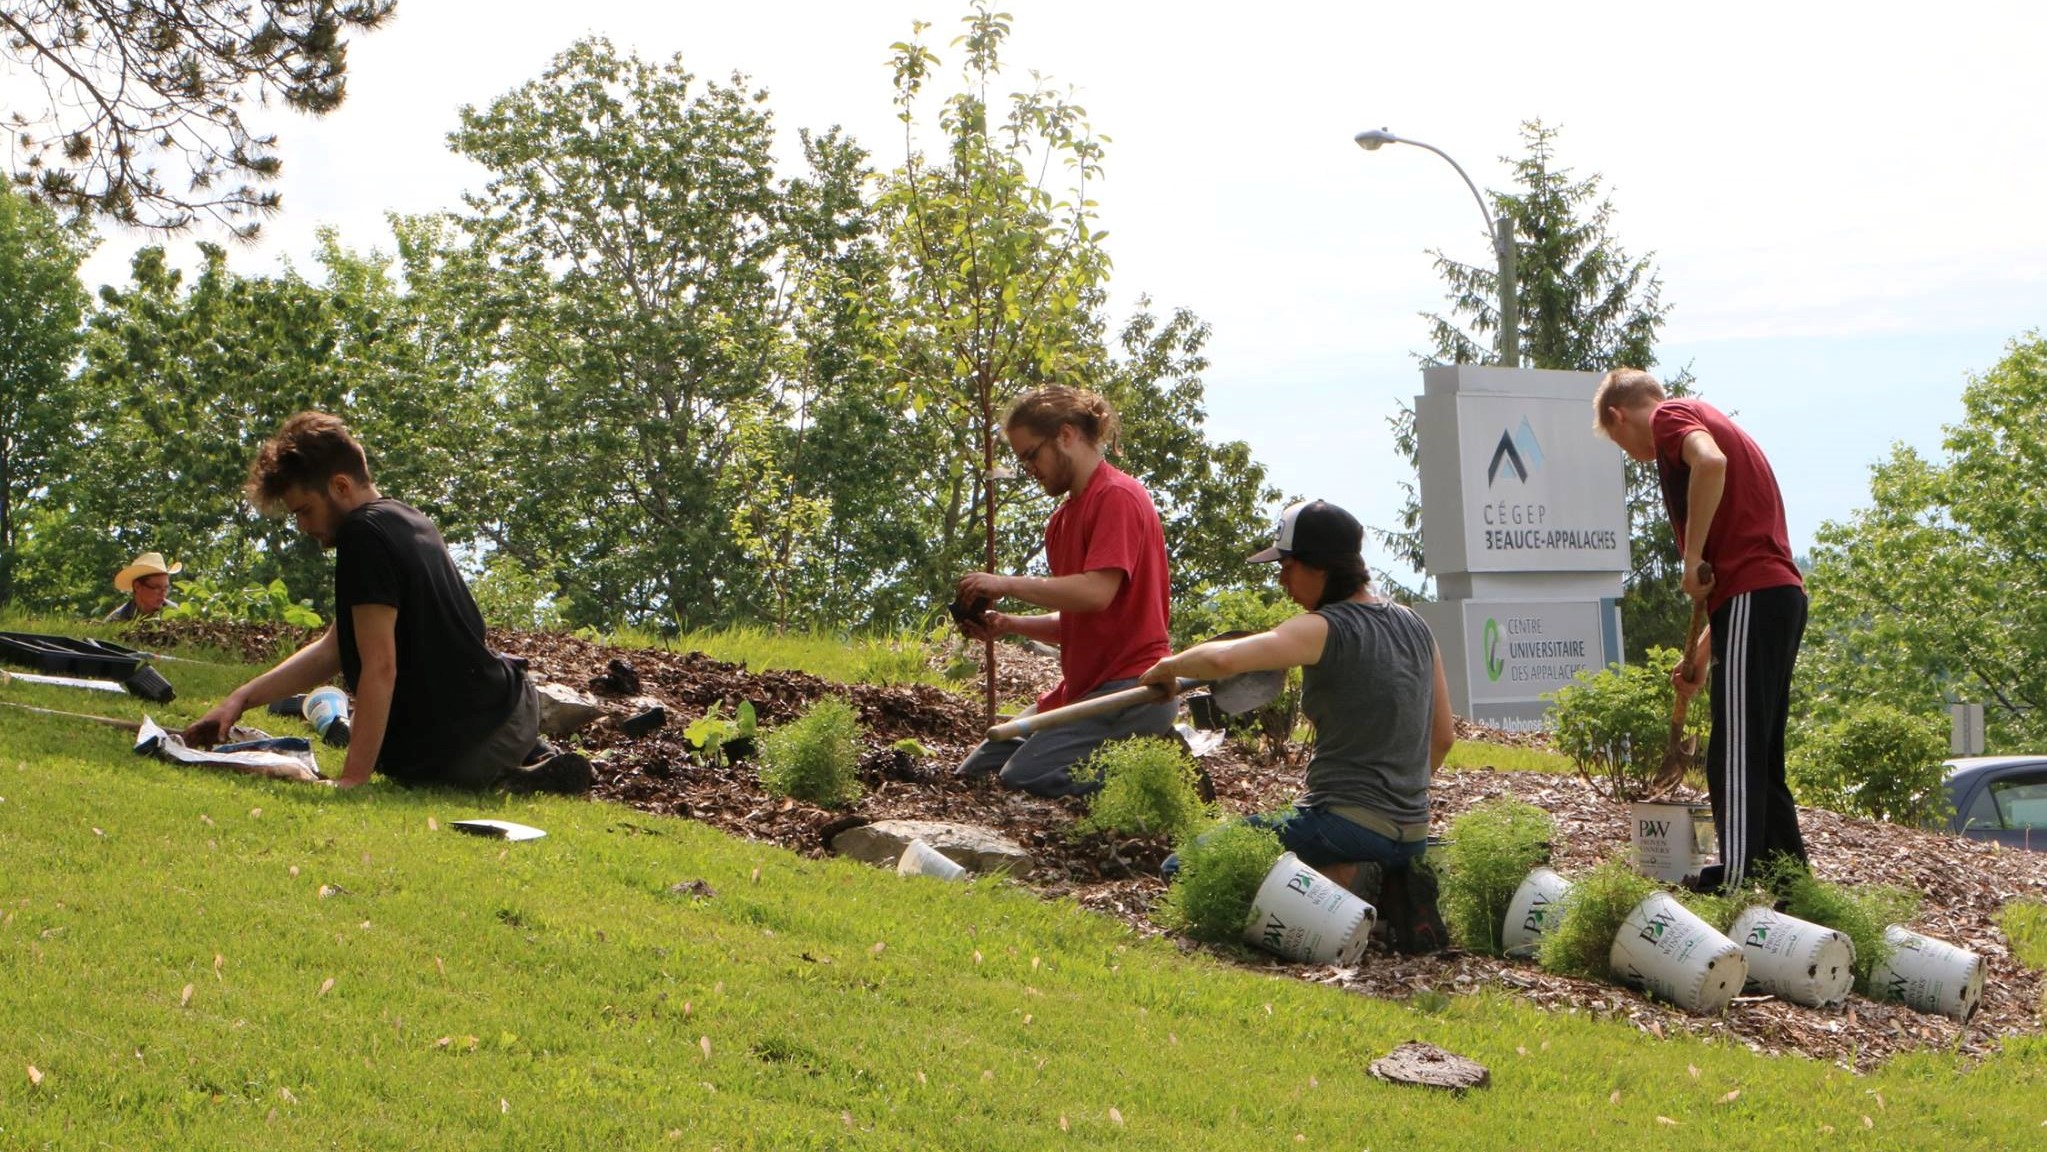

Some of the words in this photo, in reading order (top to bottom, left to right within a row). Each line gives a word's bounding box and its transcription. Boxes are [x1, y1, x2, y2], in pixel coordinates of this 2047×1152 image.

[1484, 501, 1546, 525] CÉGEP
[1485, 530, 1616, 550] BEAUCE-APPALACHES
[1508, 619, 1543, 634] CENTRE
[1510, 641, 1585, 658] UNIVERSITAIRE
[1512, 666, 1528, 681] DES
[1503, 716, 1542, 732] Alphonse
